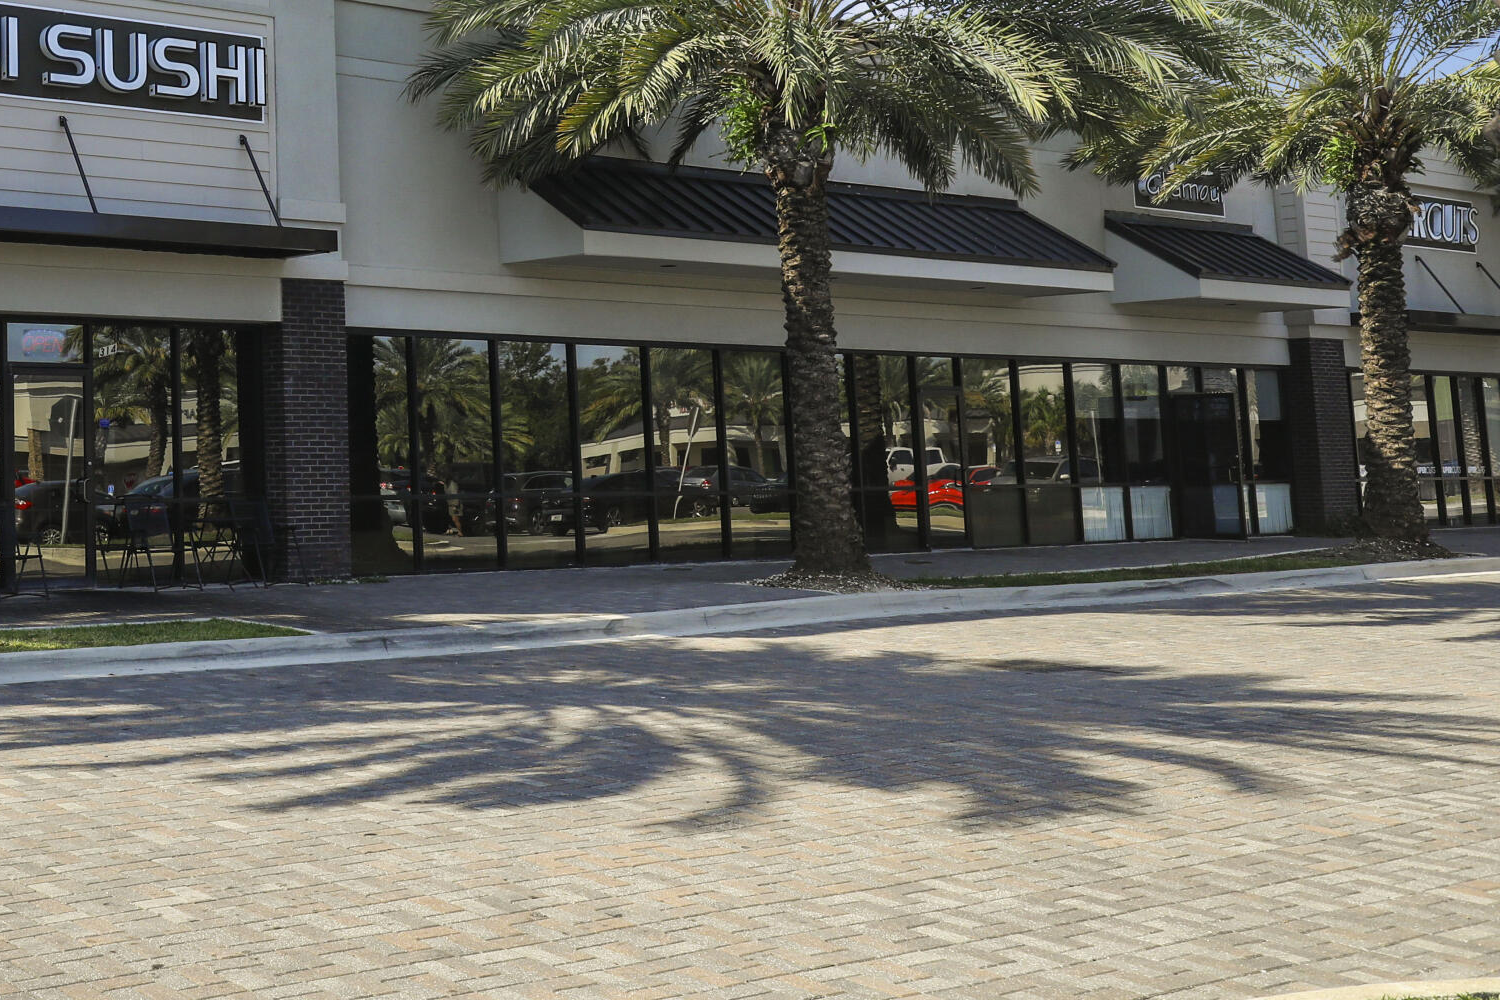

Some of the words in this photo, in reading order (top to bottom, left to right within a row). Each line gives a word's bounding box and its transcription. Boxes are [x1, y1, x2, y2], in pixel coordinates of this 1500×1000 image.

[39, 22, 266, 107] SUSHI
[1408, 202, 1480, 245] RCUTS
[23, 335, 65, 353] OPEN
[100, 344, 117, 357] 314
